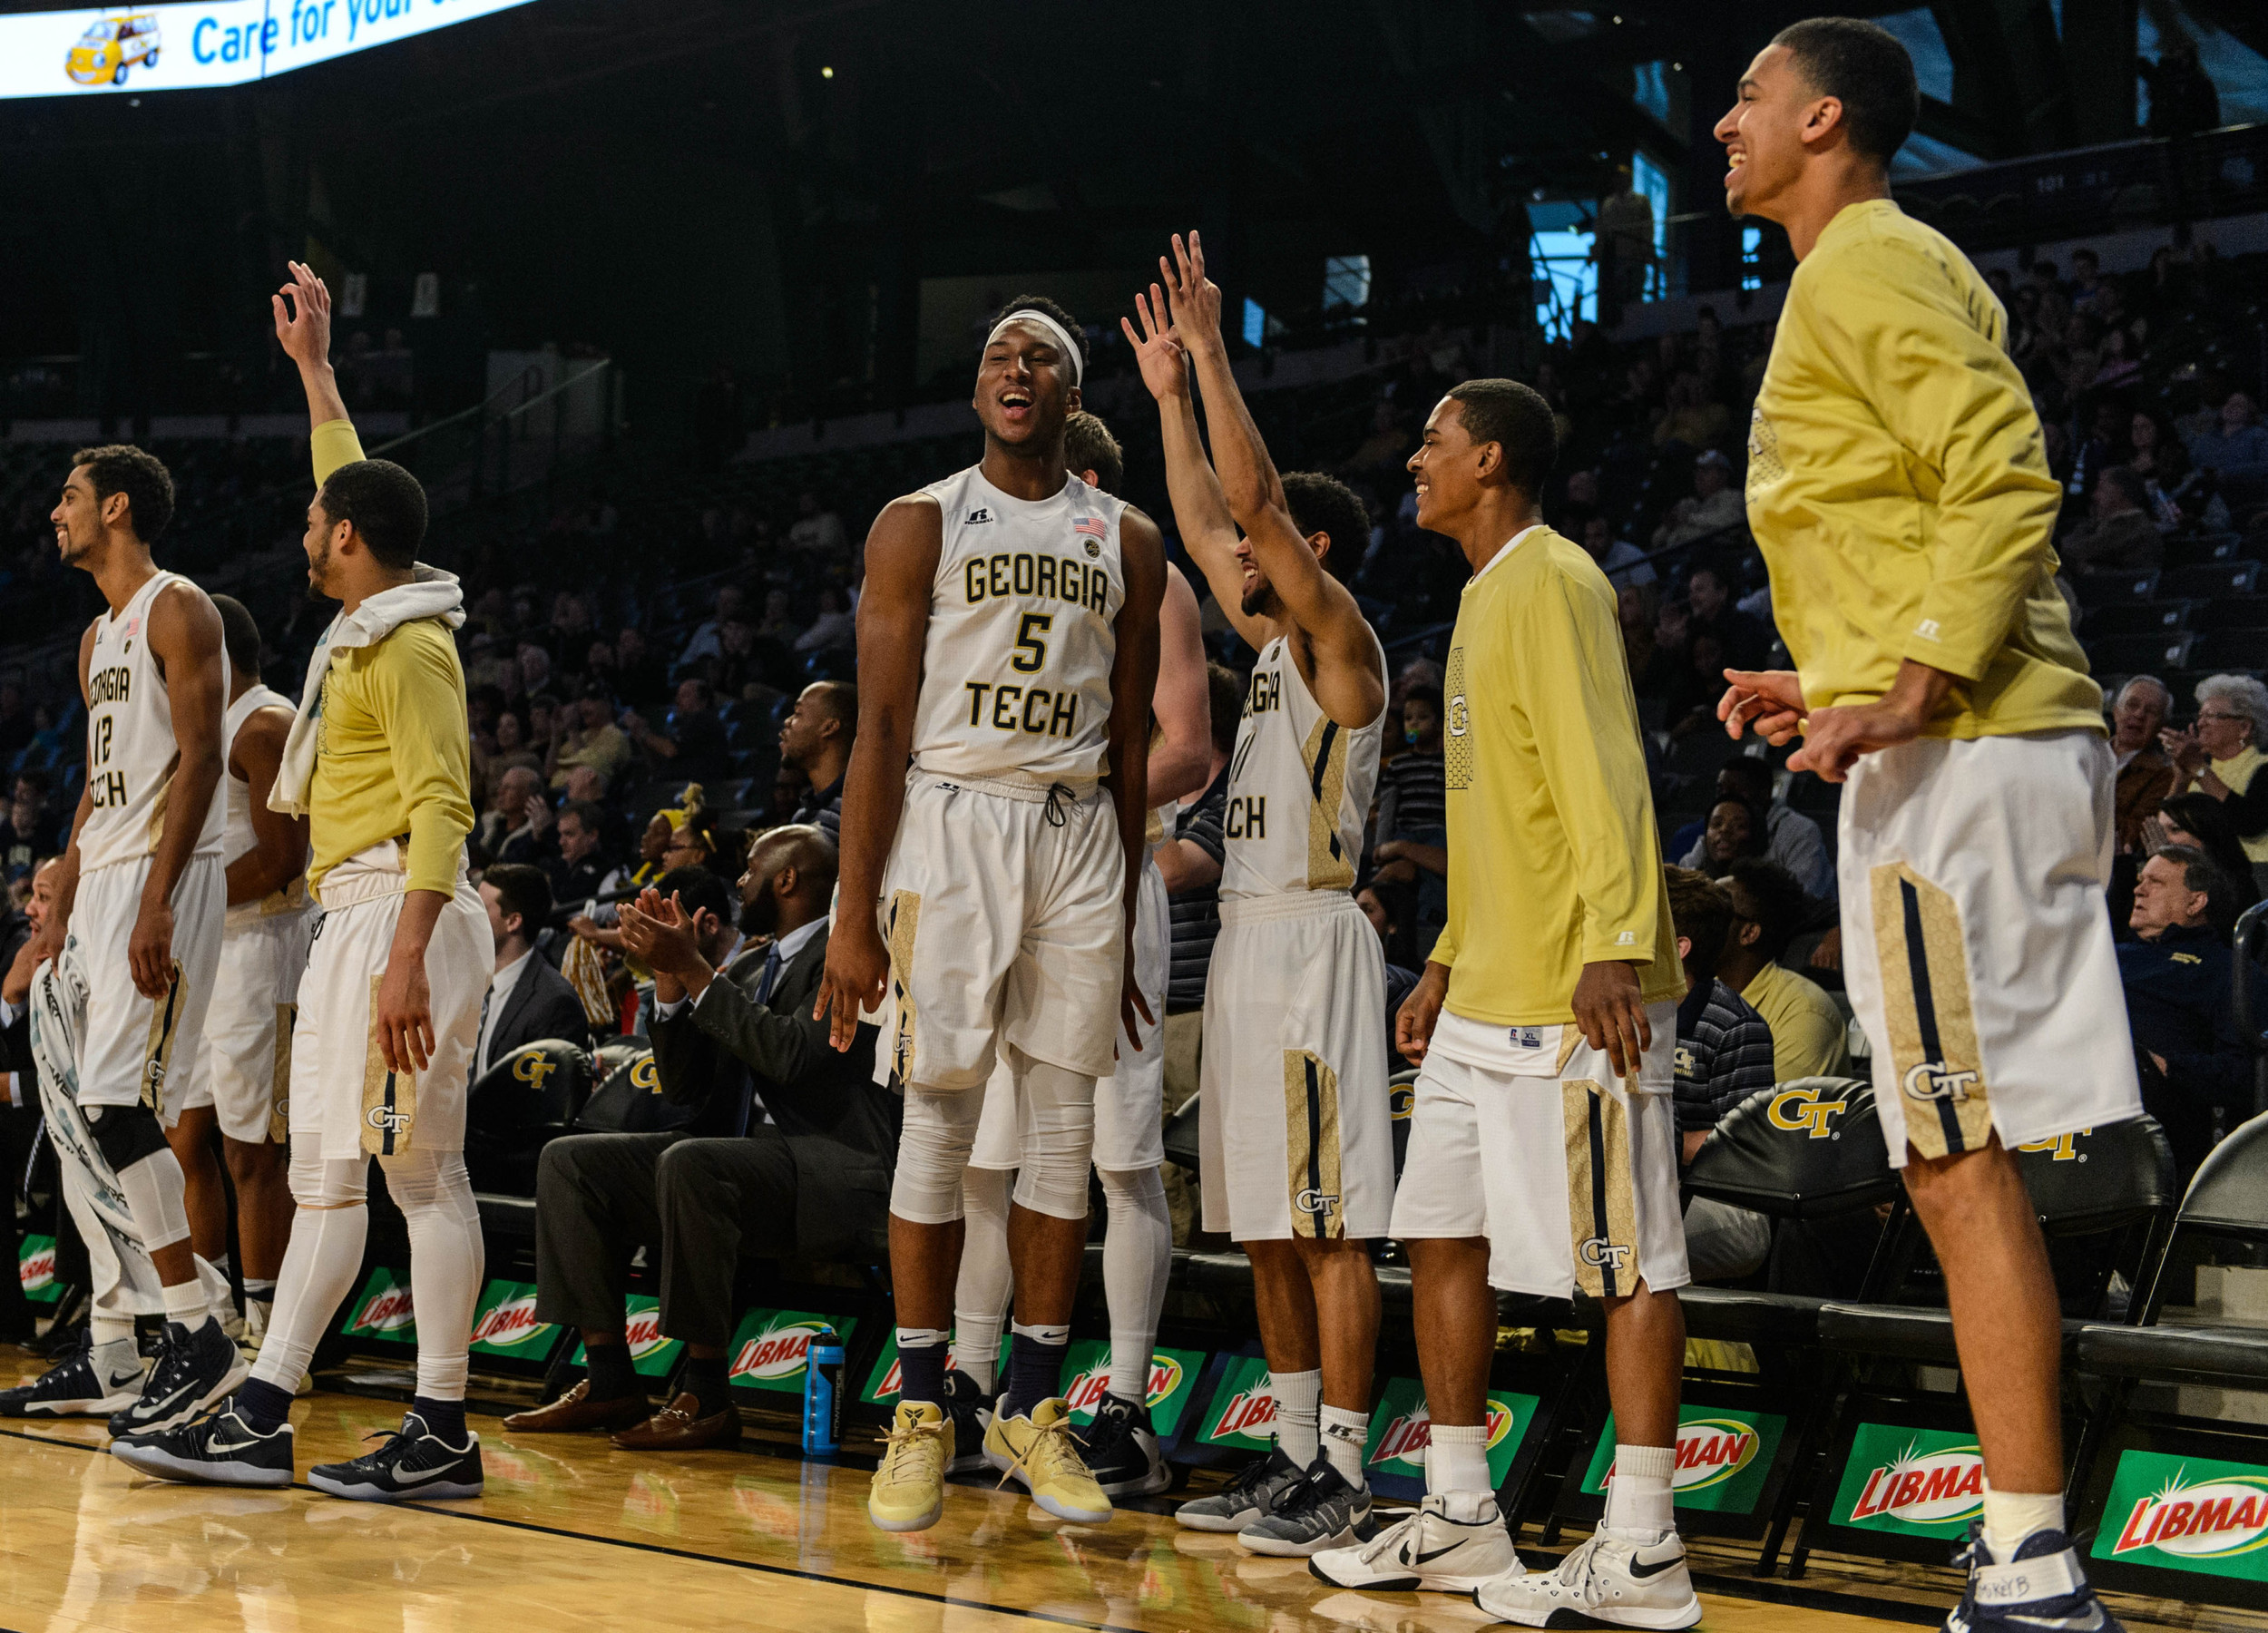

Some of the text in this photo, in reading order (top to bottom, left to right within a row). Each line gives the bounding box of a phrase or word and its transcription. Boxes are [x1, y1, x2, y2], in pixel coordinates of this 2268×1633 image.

[192, 17, 279, 64] Care
[291, 0, 336, 46] for
[964, 552, 1109, 619] GEORGIA
[1011, 611, 1054, 675] 5
[964, 681, 1079, 739] TECH
[94, 714, 112, 766] 12
[1903, 1061, 1979, 1102] GT
[366, 1104, 411, 1134] GT
[1767, 1089, 1847, 1139] GT
[1295, 1188, 1340, 1217] GT
[1579, 1237, 1629, 1269] GT
[729, 1334, 811, 1378] LIBMA
[1850, 1462, 1984, 1521] LIBMA
